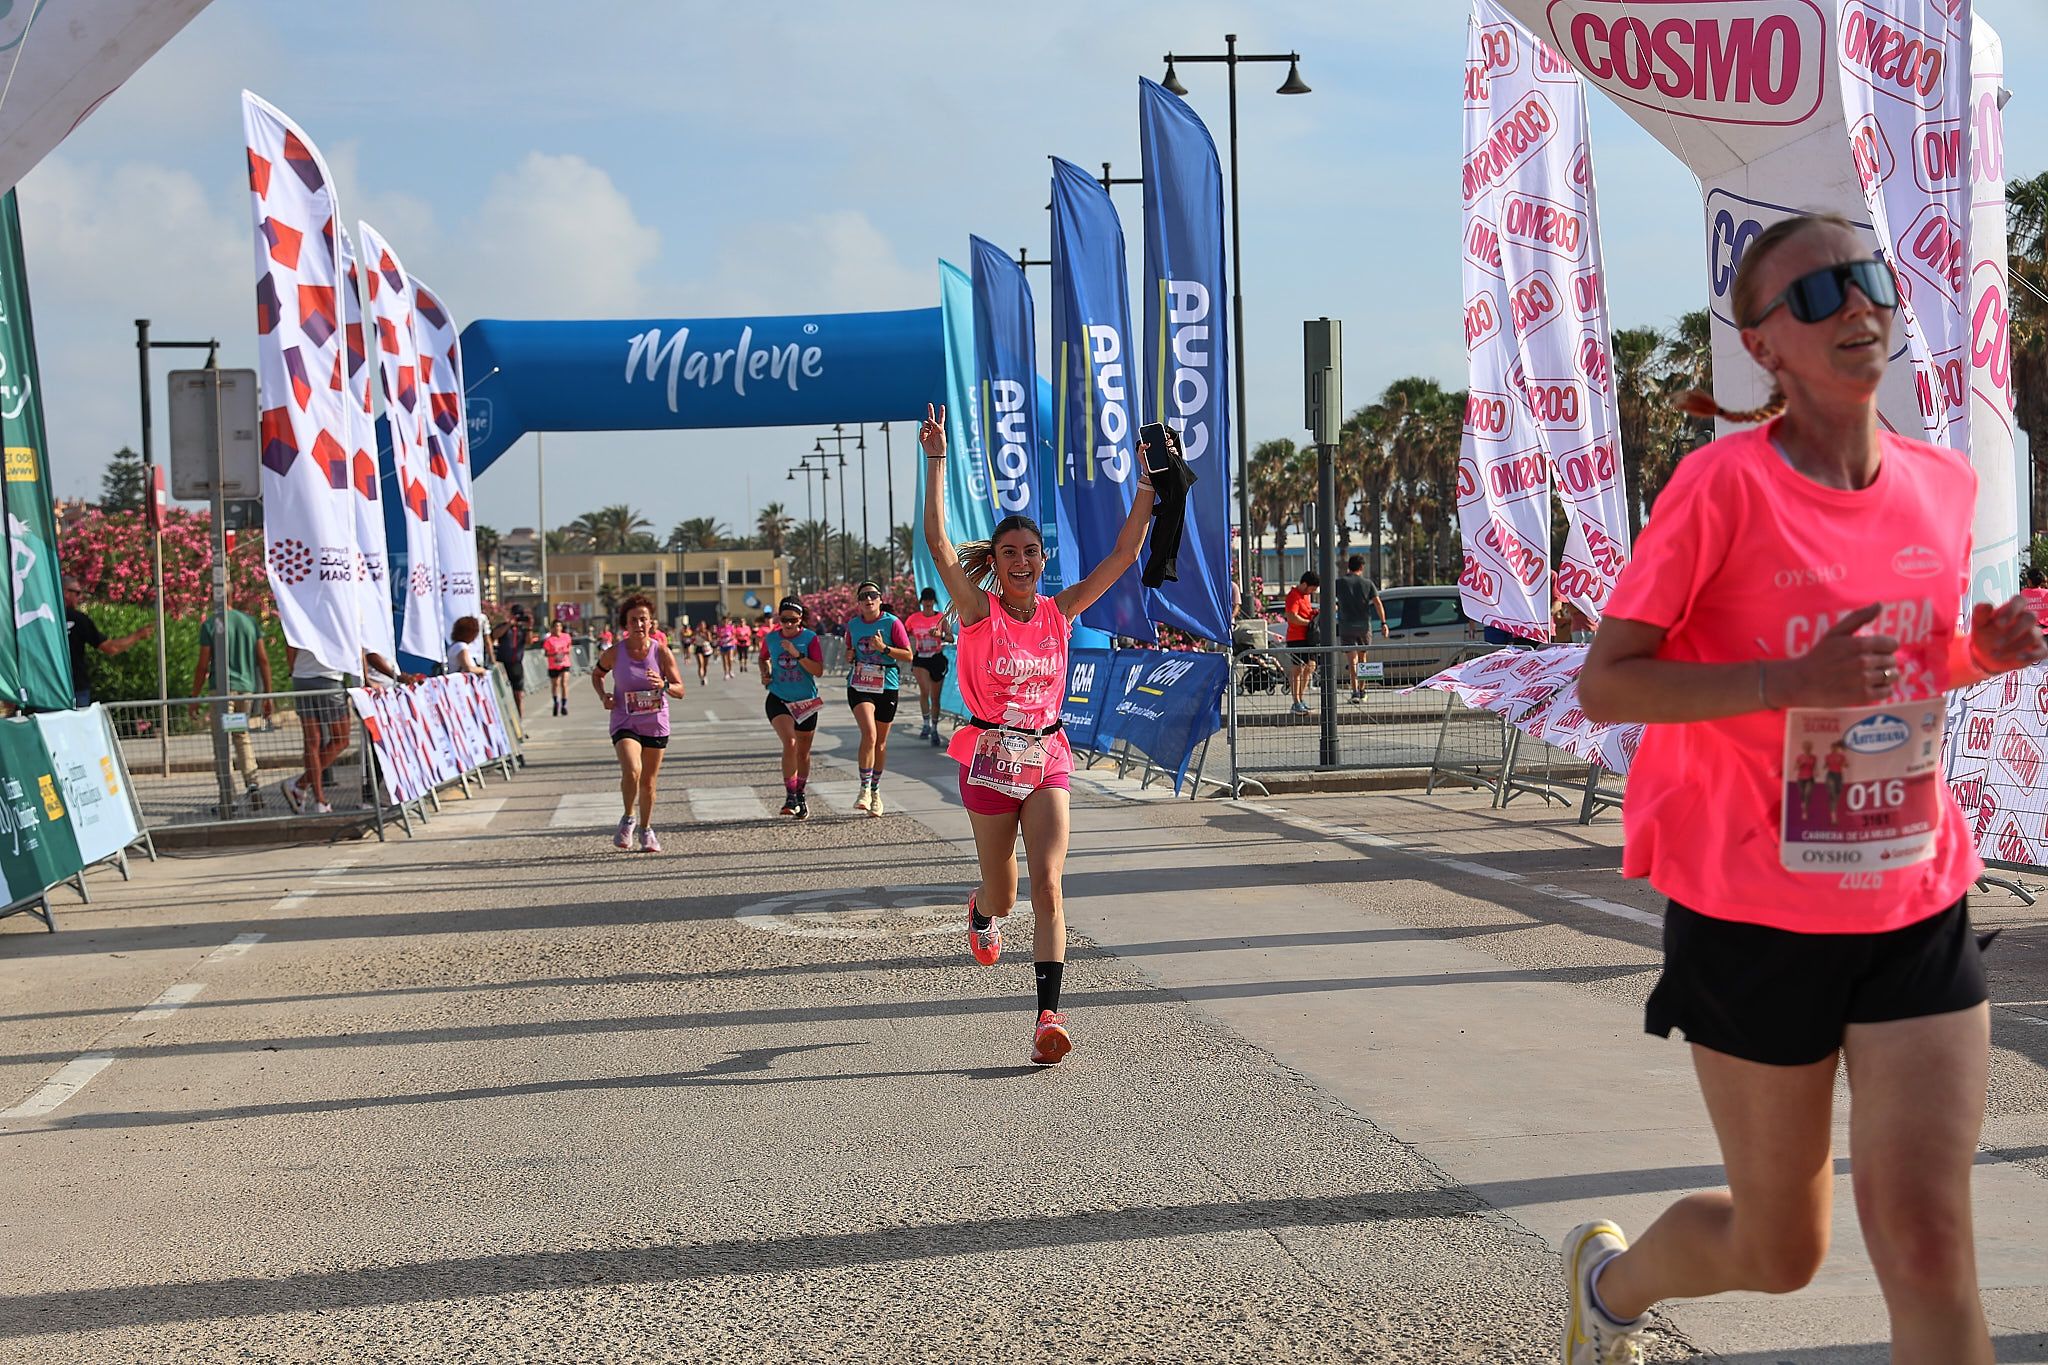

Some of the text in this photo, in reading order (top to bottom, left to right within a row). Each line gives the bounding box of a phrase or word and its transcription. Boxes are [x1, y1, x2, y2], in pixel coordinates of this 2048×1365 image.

[1570, 12, 1801, 106] COSMO
[624, 325, 824, 413] Marlene
[1775, 563, 1847, 589] OYSHO
[1785, 597, 1934, 658] CAERA
[1071, 663, 1095, 695] GOYA
[1146, 659, 1195, 687] GOYA
[1966, 716, 1994, 751] COS
[996, 760, 1023, 774] 016
[2002, 726, 2041, 788] COSMO
[1846, 779, 1905, 811] 016
[1952, 776, 1982, 812] OSMO
[1802, 850, 1862, 864] OYSHO
